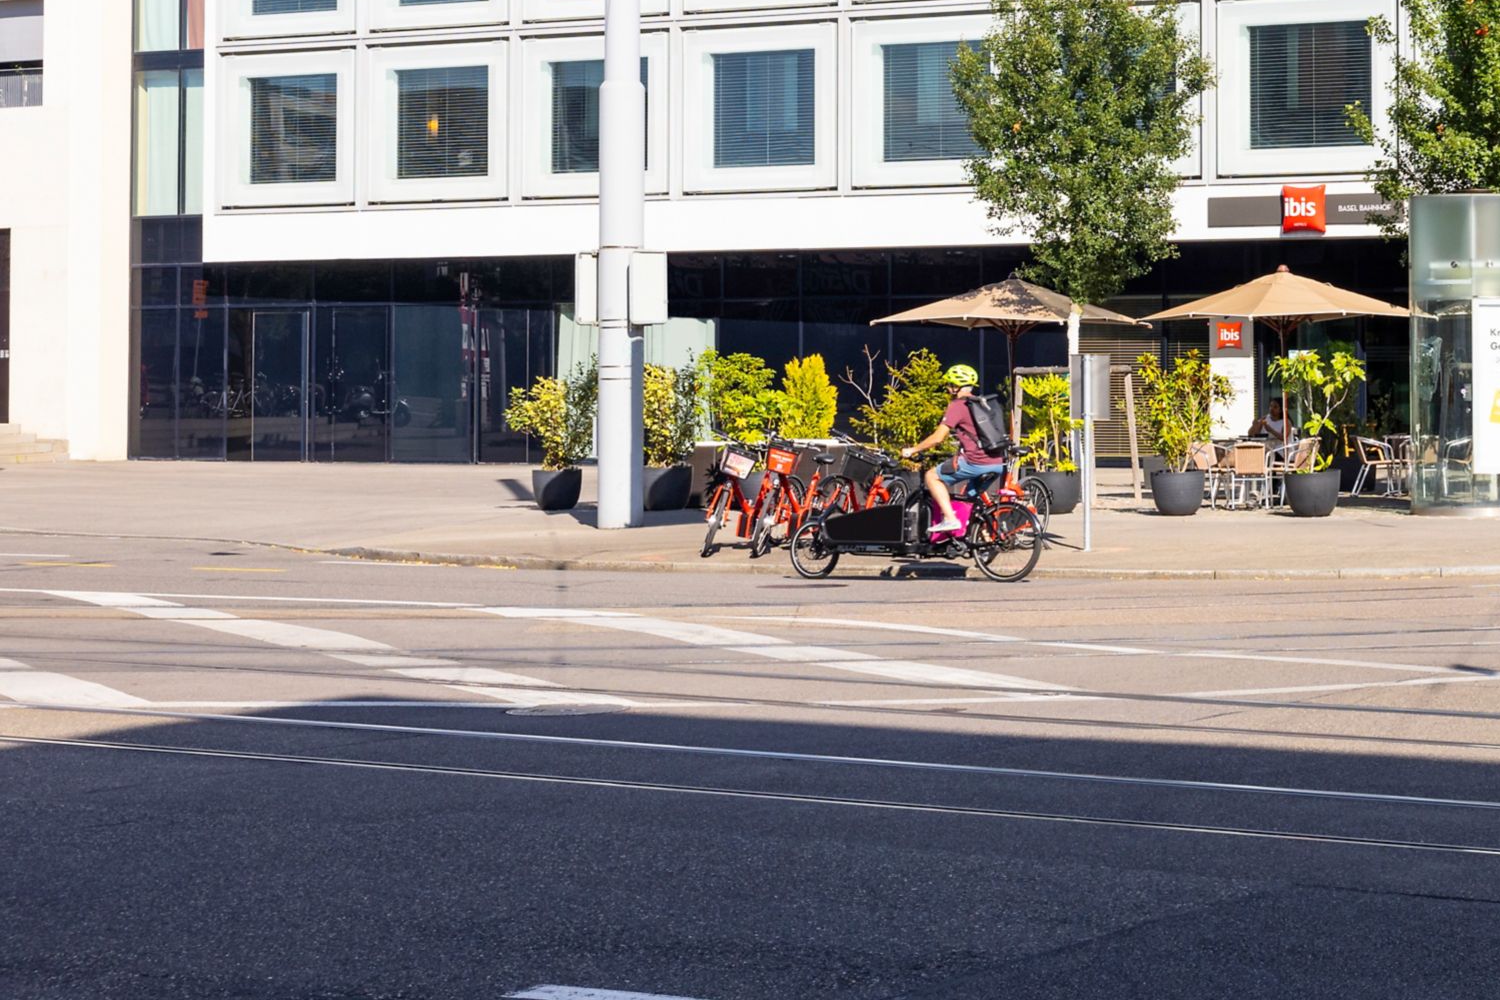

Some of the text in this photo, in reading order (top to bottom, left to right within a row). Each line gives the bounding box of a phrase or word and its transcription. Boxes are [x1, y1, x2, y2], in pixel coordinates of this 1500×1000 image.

[1284, 197, 1317, 217] ibis
[1338, 204, 1358, 212] BASEL
[1220, 328, 1240, 341] ibis
